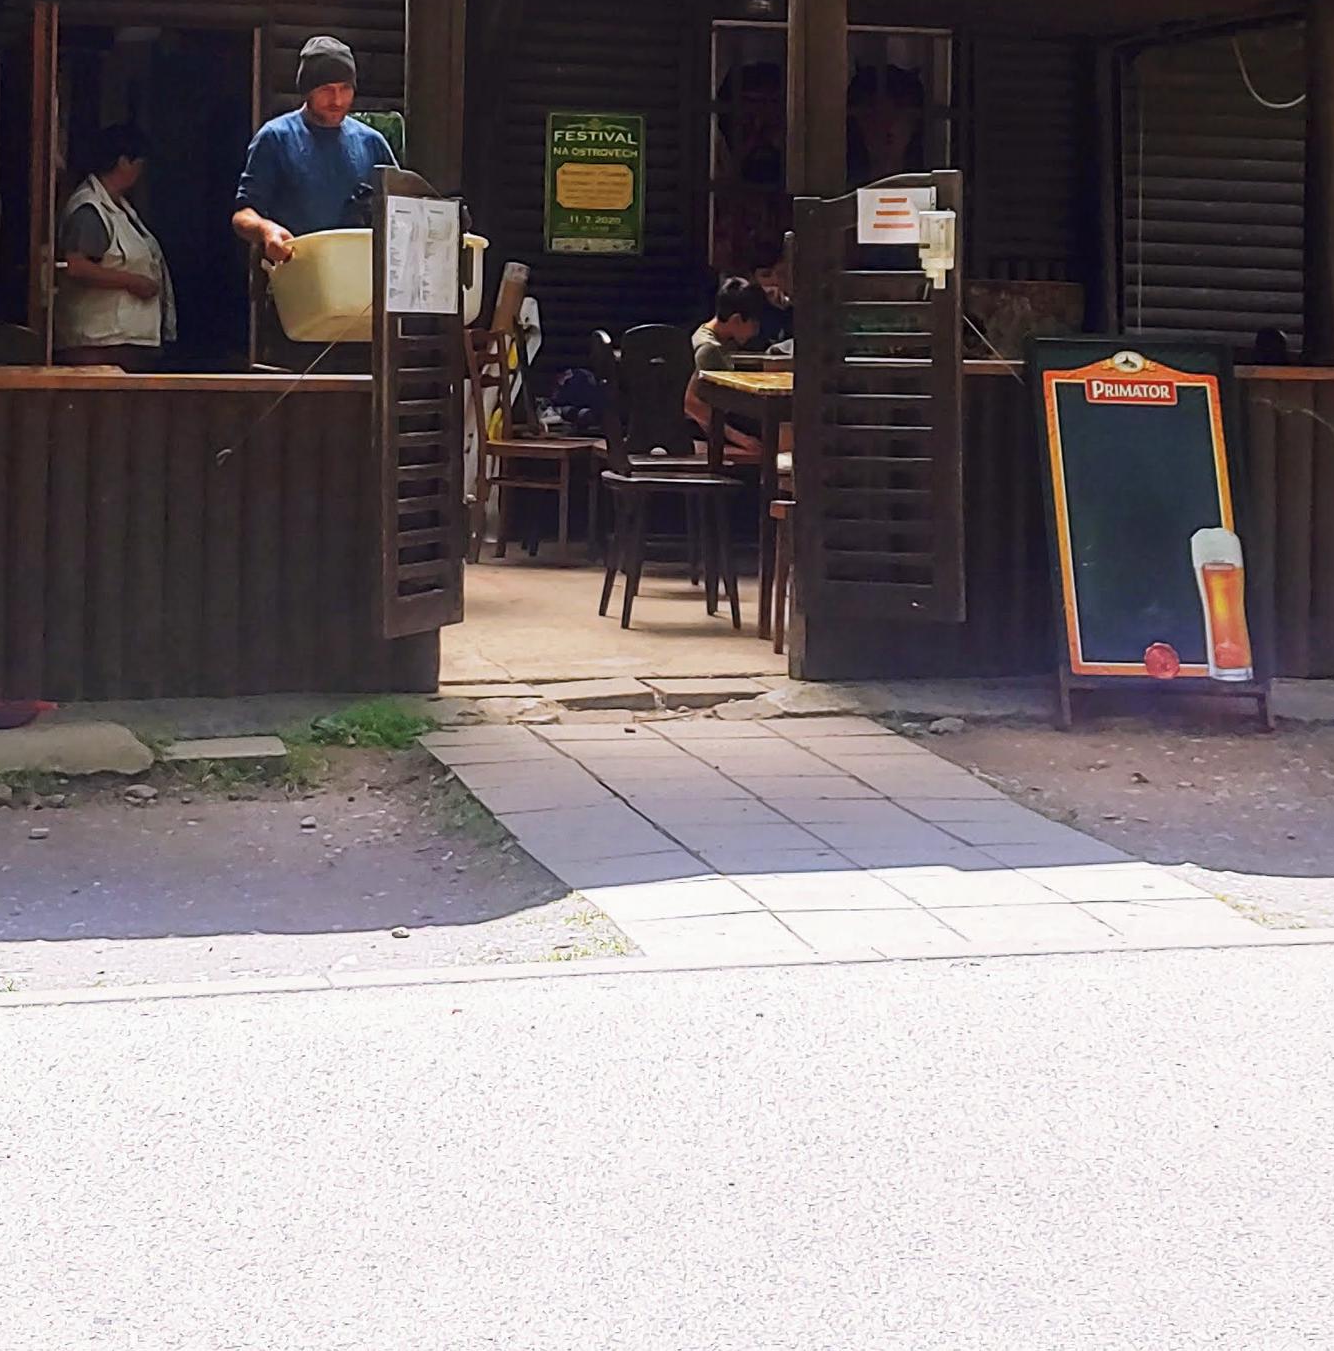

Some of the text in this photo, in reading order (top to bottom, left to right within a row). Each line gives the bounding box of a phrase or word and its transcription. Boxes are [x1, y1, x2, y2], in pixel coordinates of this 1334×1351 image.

[554, 130, 638, 145] FESTIVAL
[553, 147, 638, 158] NA OSTROVECH
[1091, 380, 1171, 399] PRIMATOR
